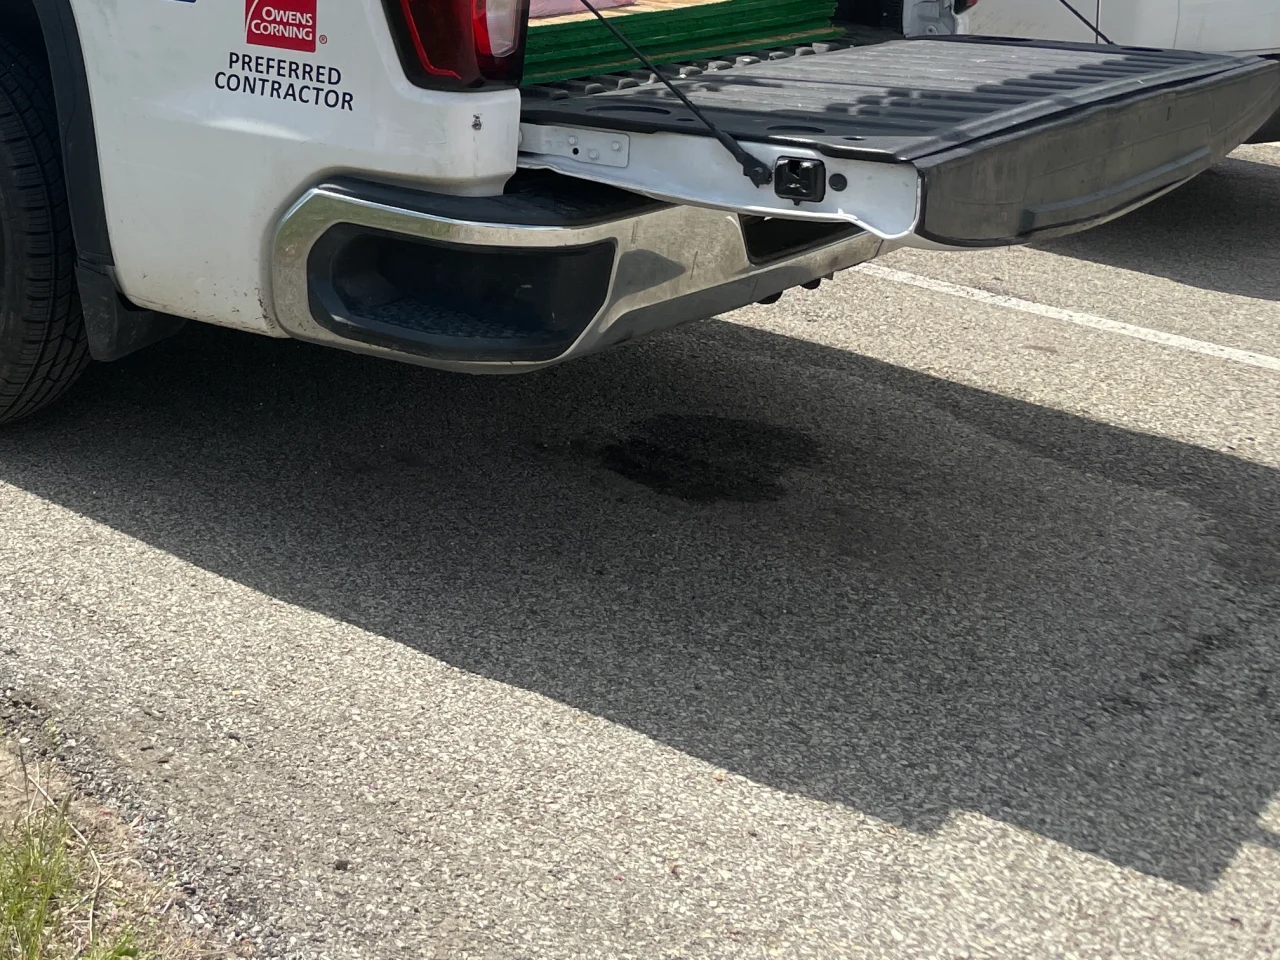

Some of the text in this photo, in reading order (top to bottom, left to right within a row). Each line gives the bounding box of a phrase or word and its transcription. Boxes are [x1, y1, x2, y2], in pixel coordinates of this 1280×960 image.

[250, 19, 313, 41] CORNING
[261, 6, 313, 26] OWENS
[228, 51, 342, 86] PREFERRED
[214, 71, 354, 112] CONTRACTOR
